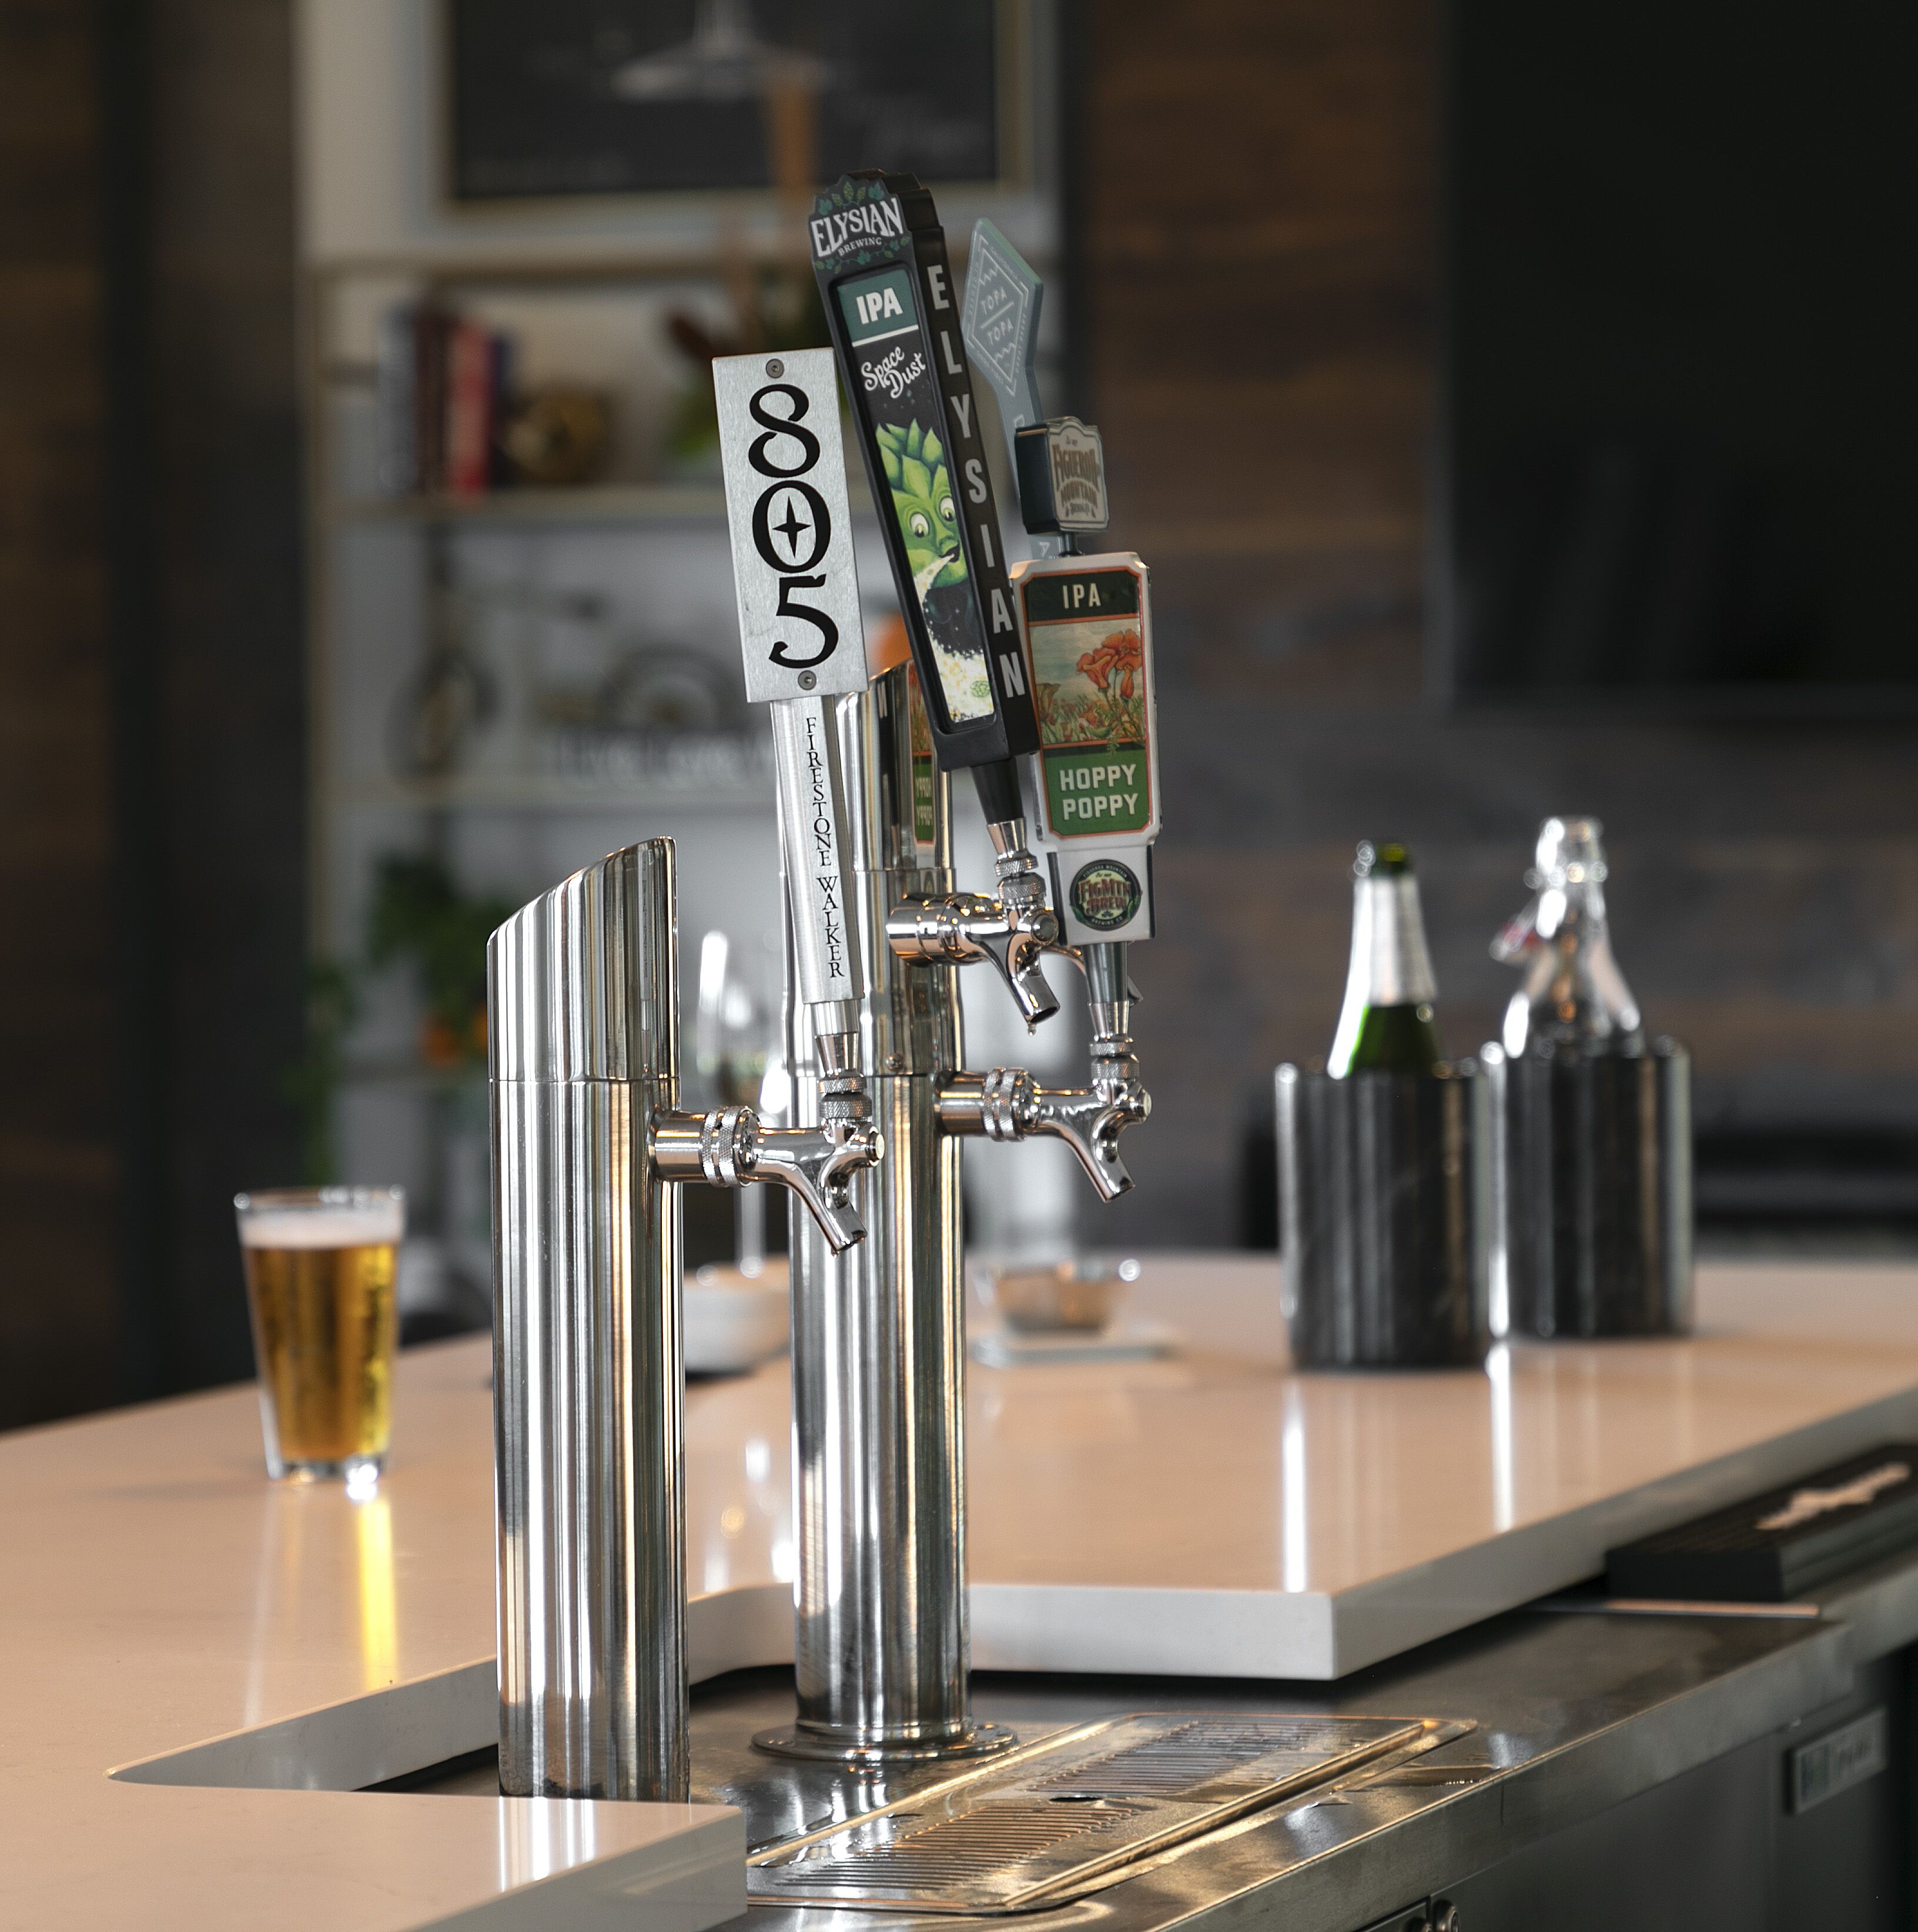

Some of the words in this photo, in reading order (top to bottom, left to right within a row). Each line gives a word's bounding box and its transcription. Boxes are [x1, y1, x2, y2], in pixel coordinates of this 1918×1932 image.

[811, 198, 904, 257] ELYSIAN
[838, 236, 882, 257] BREWING
[856, 287, 903, 324] IPA
[981, 286, 1007, 314] TOPA
[988, 317, 1013, 345] TOPA
[861, 346, 905, 391] Space
[883, 353, 926, 399] Dust
[927, 265, 1026, 698] ELYSIAN
[748, 384, 839, 669] 805
[1063, 583, 1101, 609] IPA
[806, 716, 832, 867] FIRESTONE
[1060, 764, 1136, 791] HOPPY
[1063, 793, 1138, 821] POPPY
[816, 876, 845, 978] WALKER
